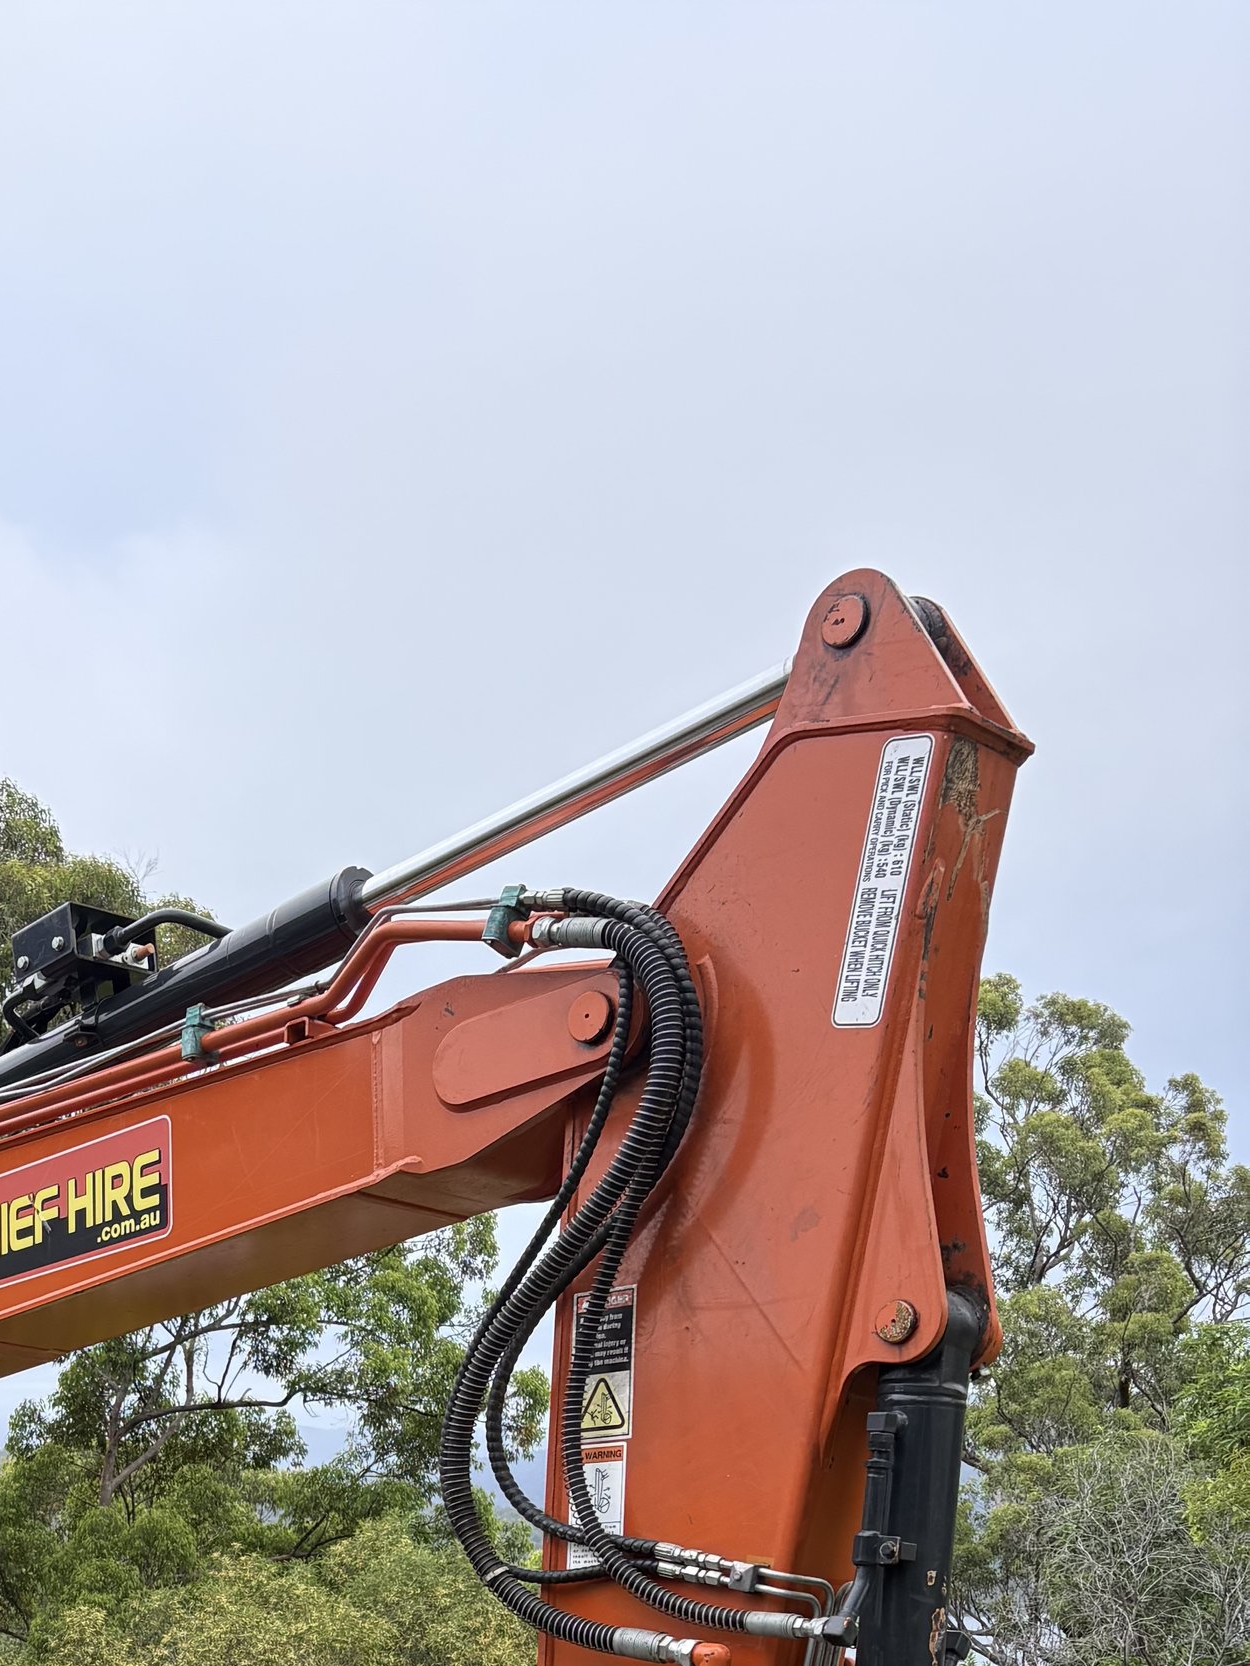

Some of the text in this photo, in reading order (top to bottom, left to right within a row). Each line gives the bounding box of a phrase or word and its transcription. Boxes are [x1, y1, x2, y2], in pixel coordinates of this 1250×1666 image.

[891, 755, 910, 795] WLL/SWL
[906, 756, 925, 798] WLL/SWL
[862, 761, 893, 883] FOR PICK AND CARRY OPERATIONS
[880, 797, 903, 837] (Dynamic)
[896, 800, 917, 831] (Static)
[890, 860, 904, 876] 610
[841, 887, 878, 1003] REMOVE BUCKET WHEN LIFTING
[861, 889, 898, 998] LIFT FROM QUICK HITCH ONLY
[67, 1149, 161, 1234] HIRE
[97, 1209, 161, 1244] .com.au
[585, 1449, 622, 1460] WARNING
